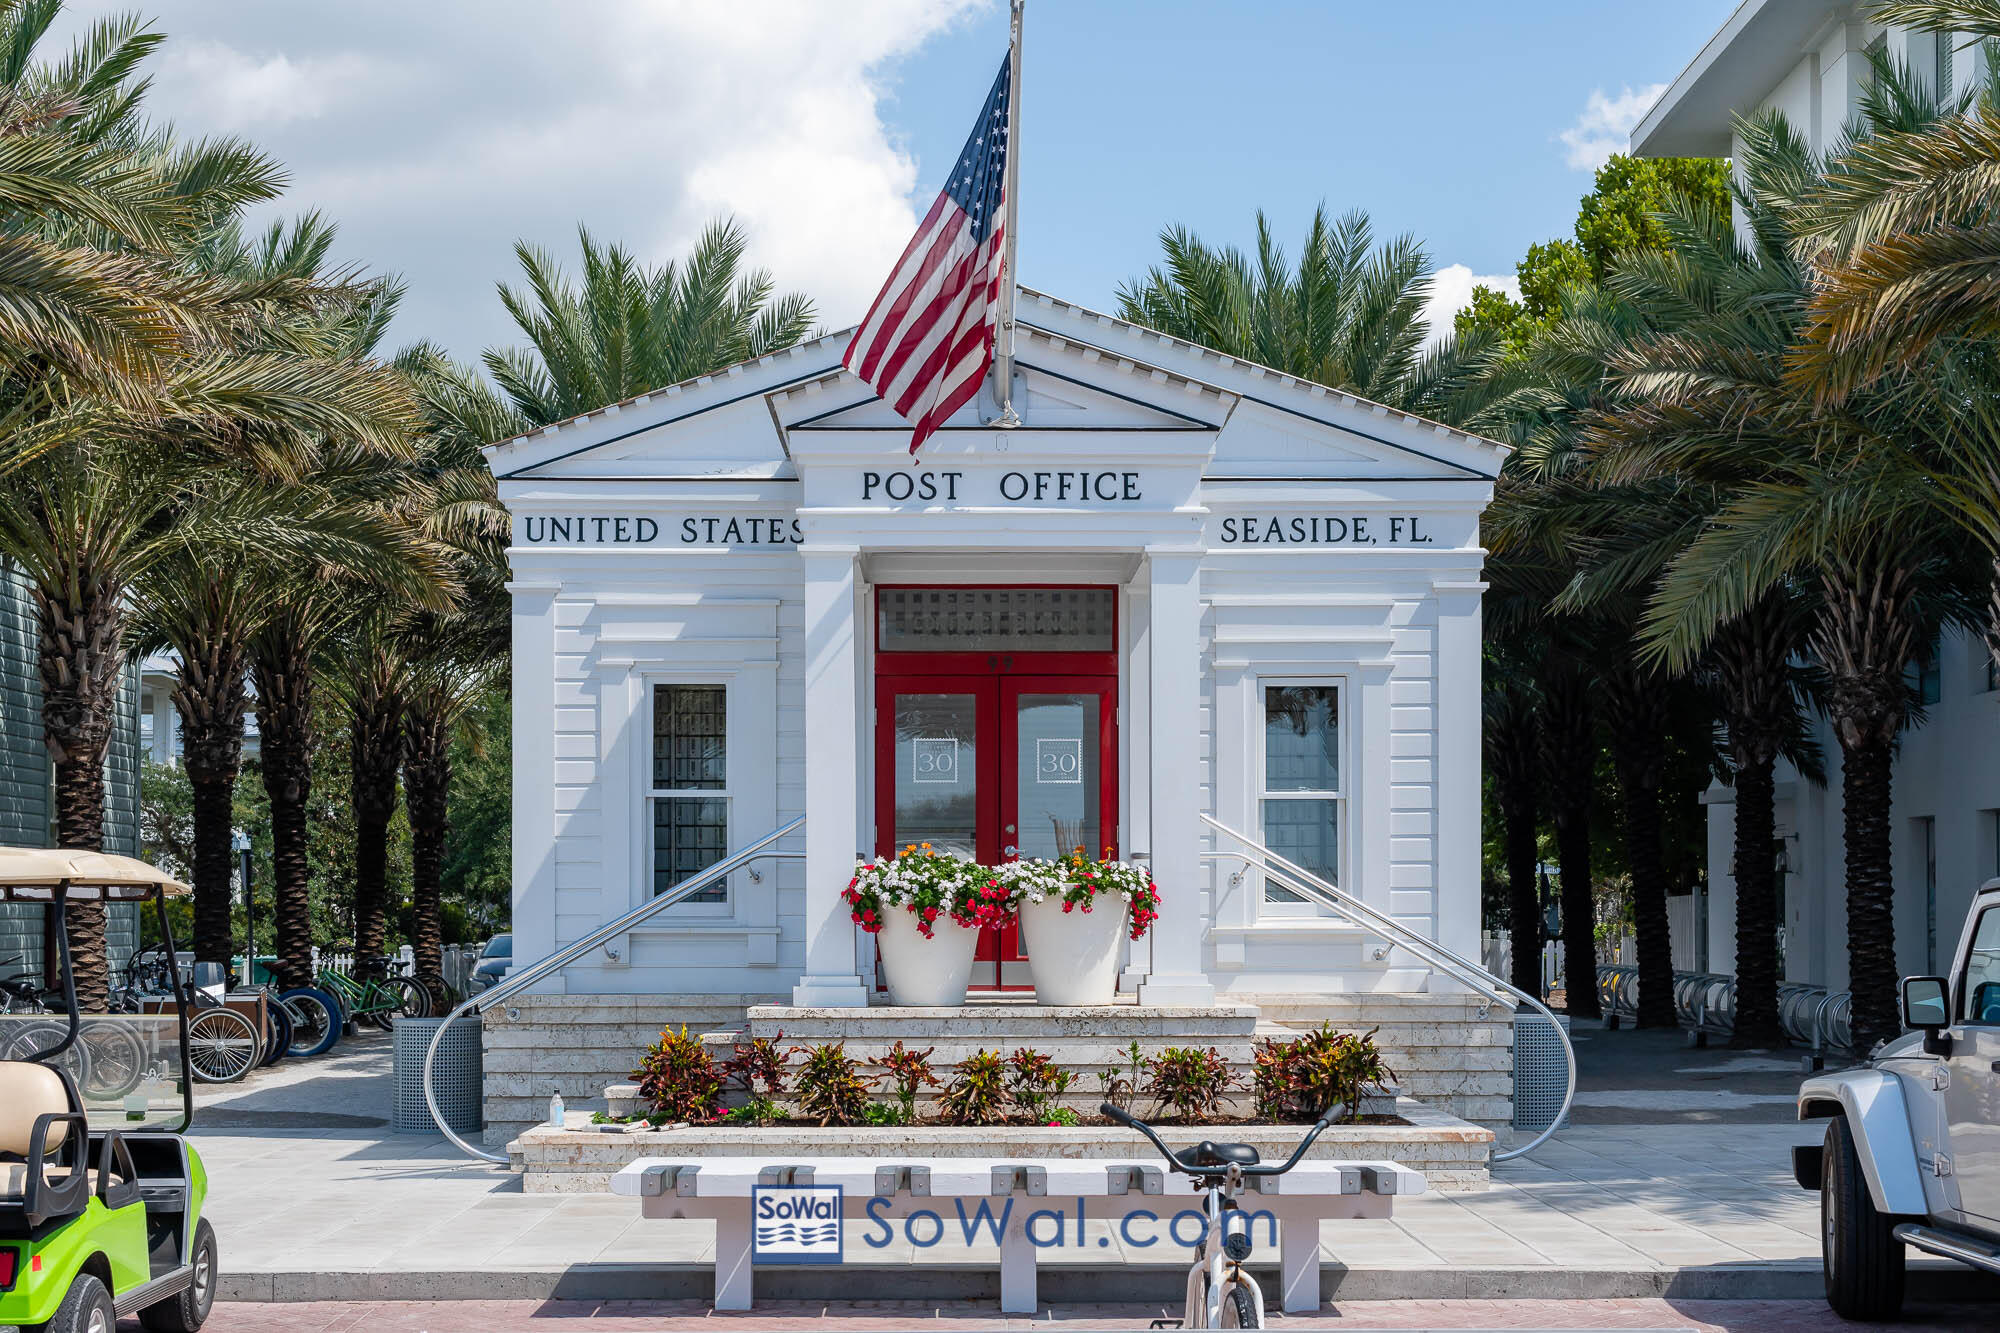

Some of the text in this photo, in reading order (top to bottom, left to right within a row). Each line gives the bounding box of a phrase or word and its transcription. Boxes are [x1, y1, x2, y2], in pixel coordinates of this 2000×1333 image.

[862, 472, 1142, 501] POST OFFICE
[525, 517, 805, 544] UNITED STATES
[1220, 517, 1433, 546] SEASIDE, FL.
[986, 655, 1014, 673] 99
[919, 753, 953, 772] 30
[1042, 753, 1076, 773] 30
